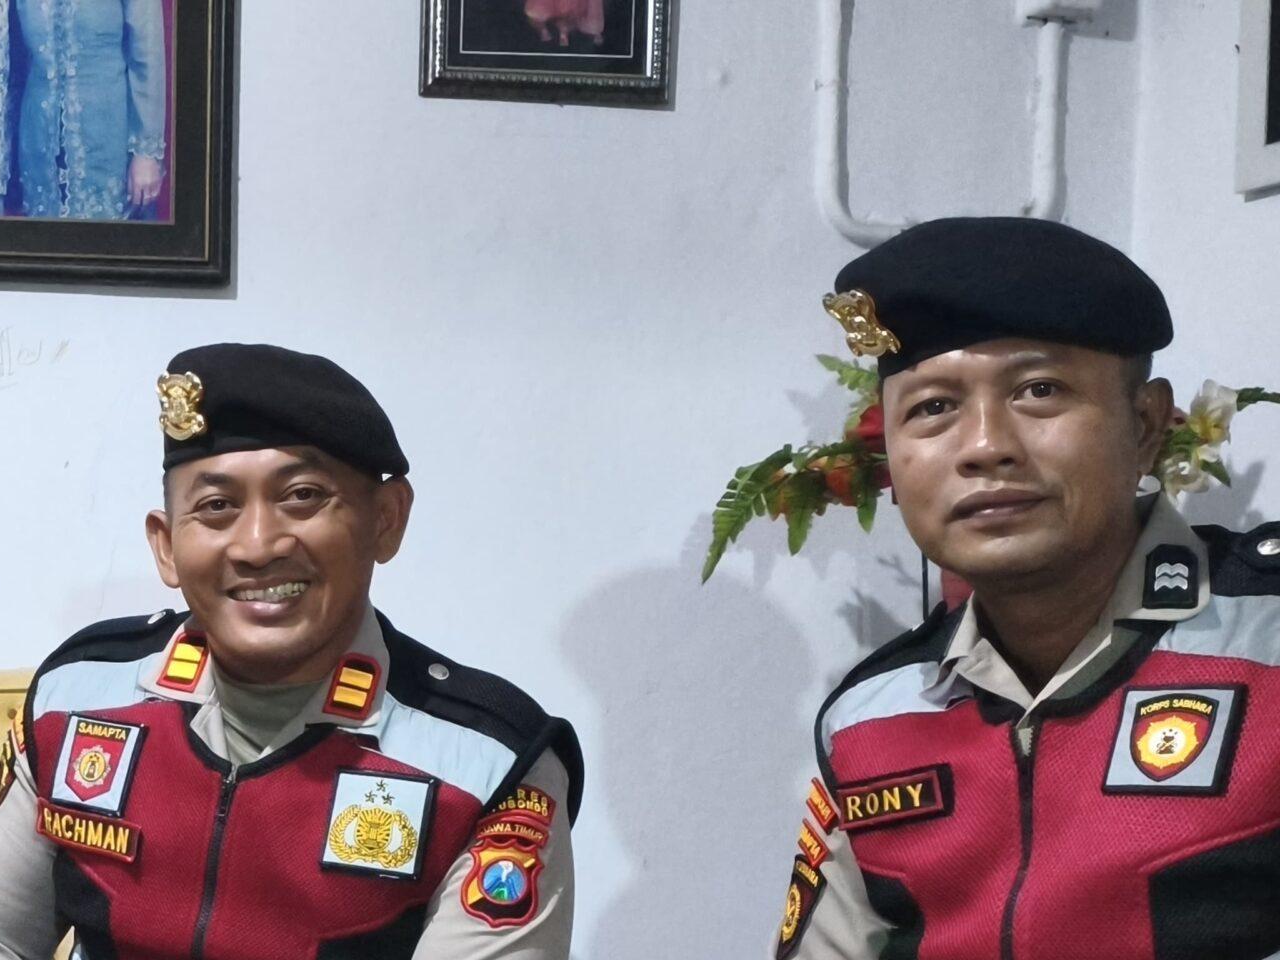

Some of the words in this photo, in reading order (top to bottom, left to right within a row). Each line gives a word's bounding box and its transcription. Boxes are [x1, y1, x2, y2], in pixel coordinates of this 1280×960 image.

[1140, 700, 1170, 715] KORPS
[1172, 699, 1213, 715] SABHARA
[77, 721, 127, 740] SAMAPTA
[846, 783, 923, 821] RONY
[43, 807, 130, 854] RACHMAN
[481, 823, 512, 834] JAWA
[514, 824, 544, 840] TIMUR
